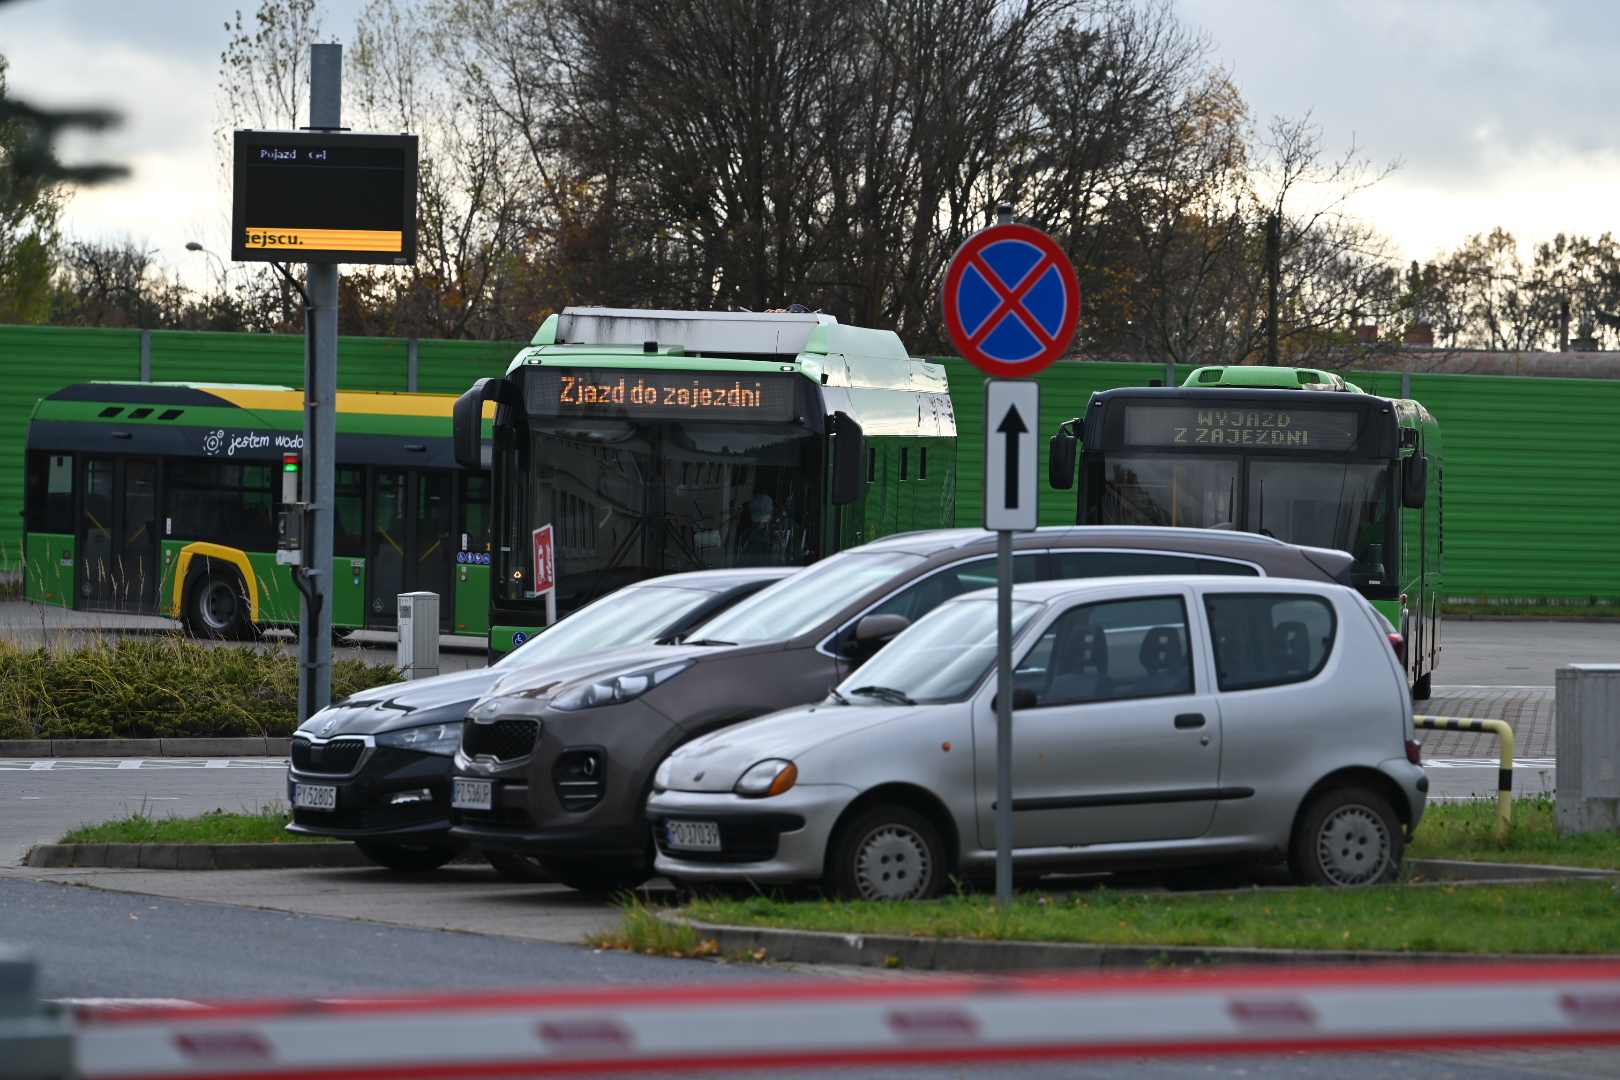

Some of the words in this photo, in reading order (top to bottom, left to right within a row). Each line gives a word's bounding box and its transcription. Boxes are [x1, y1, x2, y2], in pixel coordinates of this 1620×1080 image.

[260, 149, 297, 161] Pojazd
[308, 150, 327, 160] Cel
[560, 376, 625, 405] Zjazd
[630, 378, 657, 404] do
[663, 380, 761, 408] zajezdni
[1197, 410, 1291, 427] WYJAZD
[227, 431, 270, 456] jestem
[1174, 427, 1187, 443] Z
[1195, 428, 1308, 445] ZAJEZDNI
[308, 786, 335, 807] 52805
